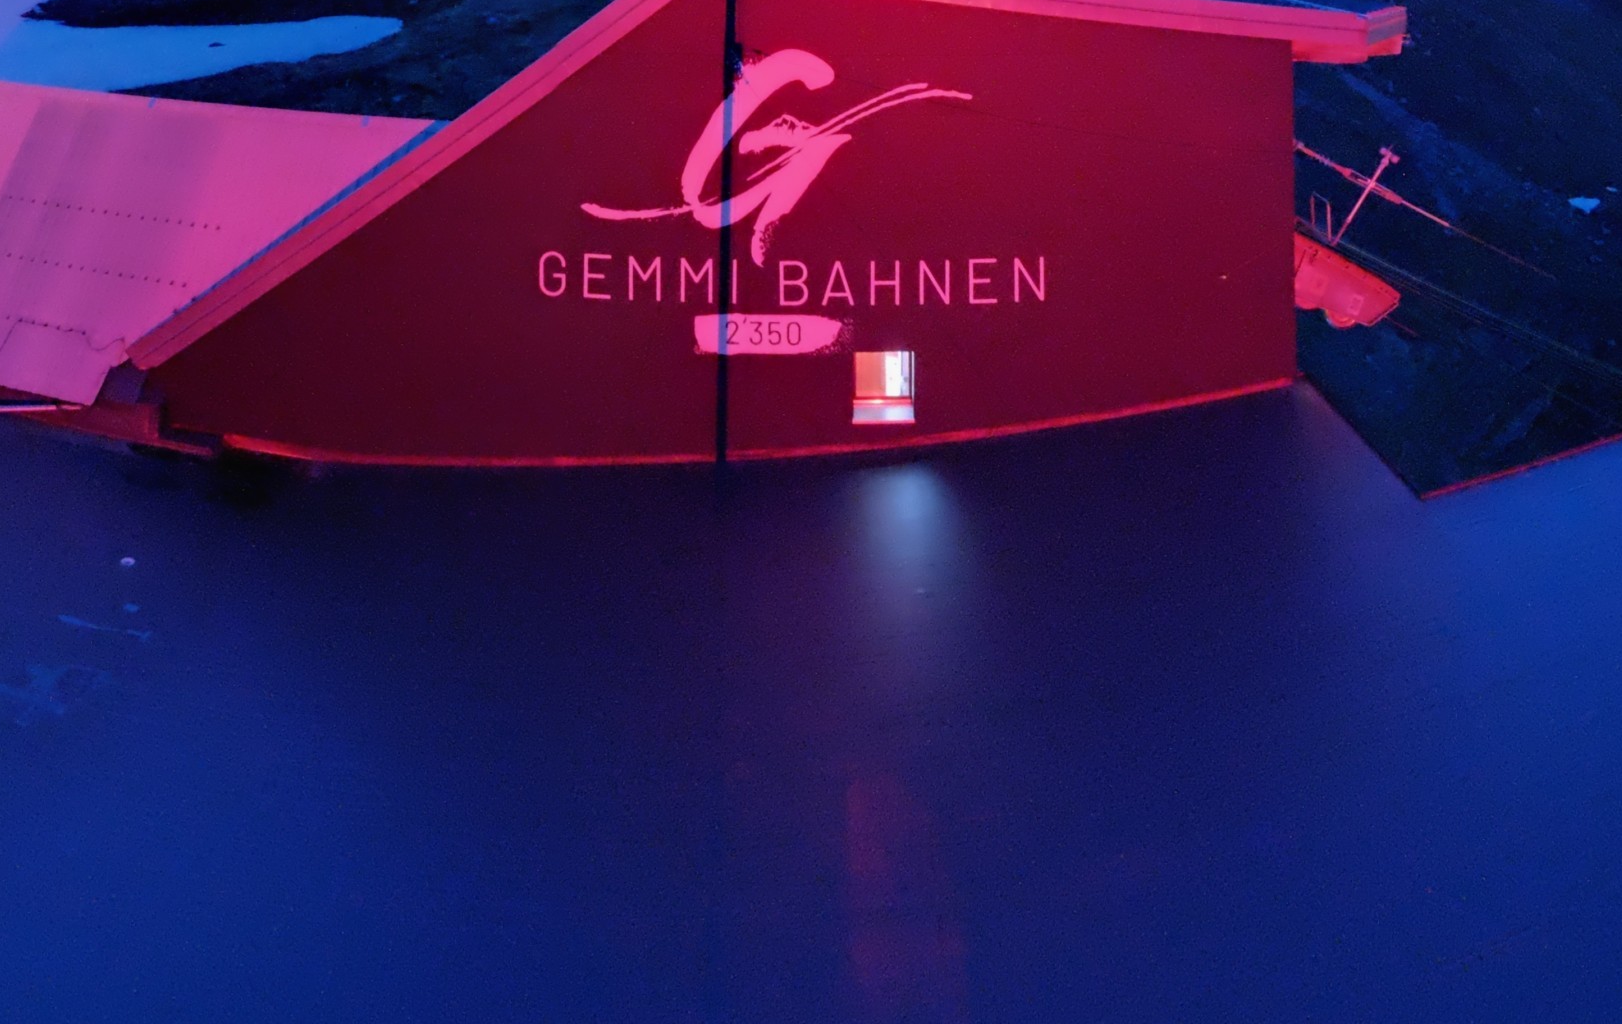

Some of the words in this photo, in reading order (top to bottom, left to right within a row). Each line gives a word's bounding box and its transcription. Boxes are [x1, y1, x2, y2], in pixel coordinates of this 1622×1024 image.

[538, 250, 738, 305] GEMMI
[778, 256, 1047, 307] BAHNEN
[724, 316, 803, 347] 2'350
